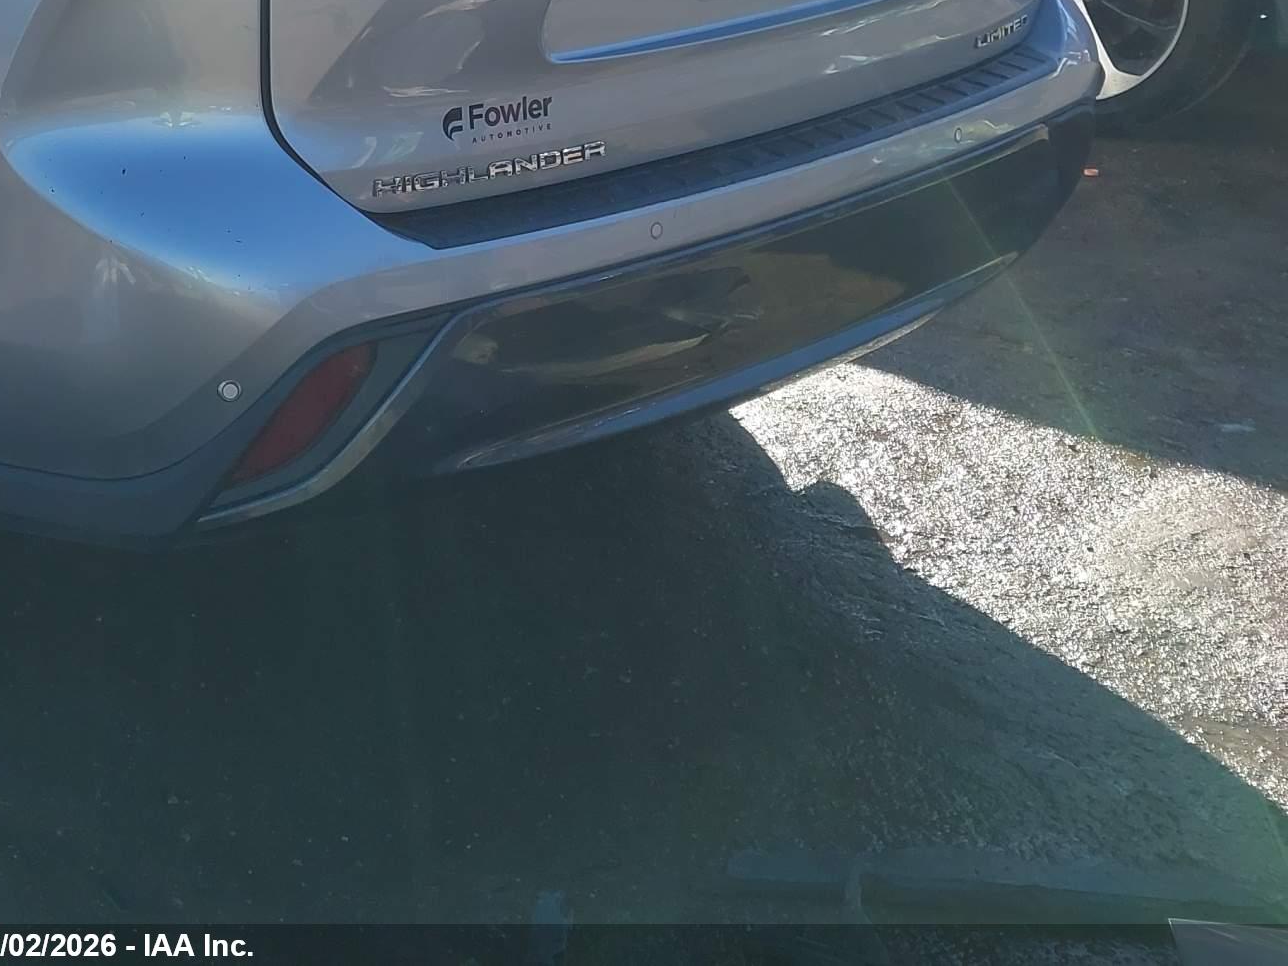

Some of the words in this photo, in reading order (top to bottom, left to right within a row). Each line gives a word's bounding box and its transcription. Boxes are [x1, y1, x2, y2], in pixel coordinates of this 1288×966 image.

[467, 96, 553, 130] Fowler
[471, 123, 552, 144] AUTOMOTIVE
[372, 140, 607, 198] HIGHLANDER
